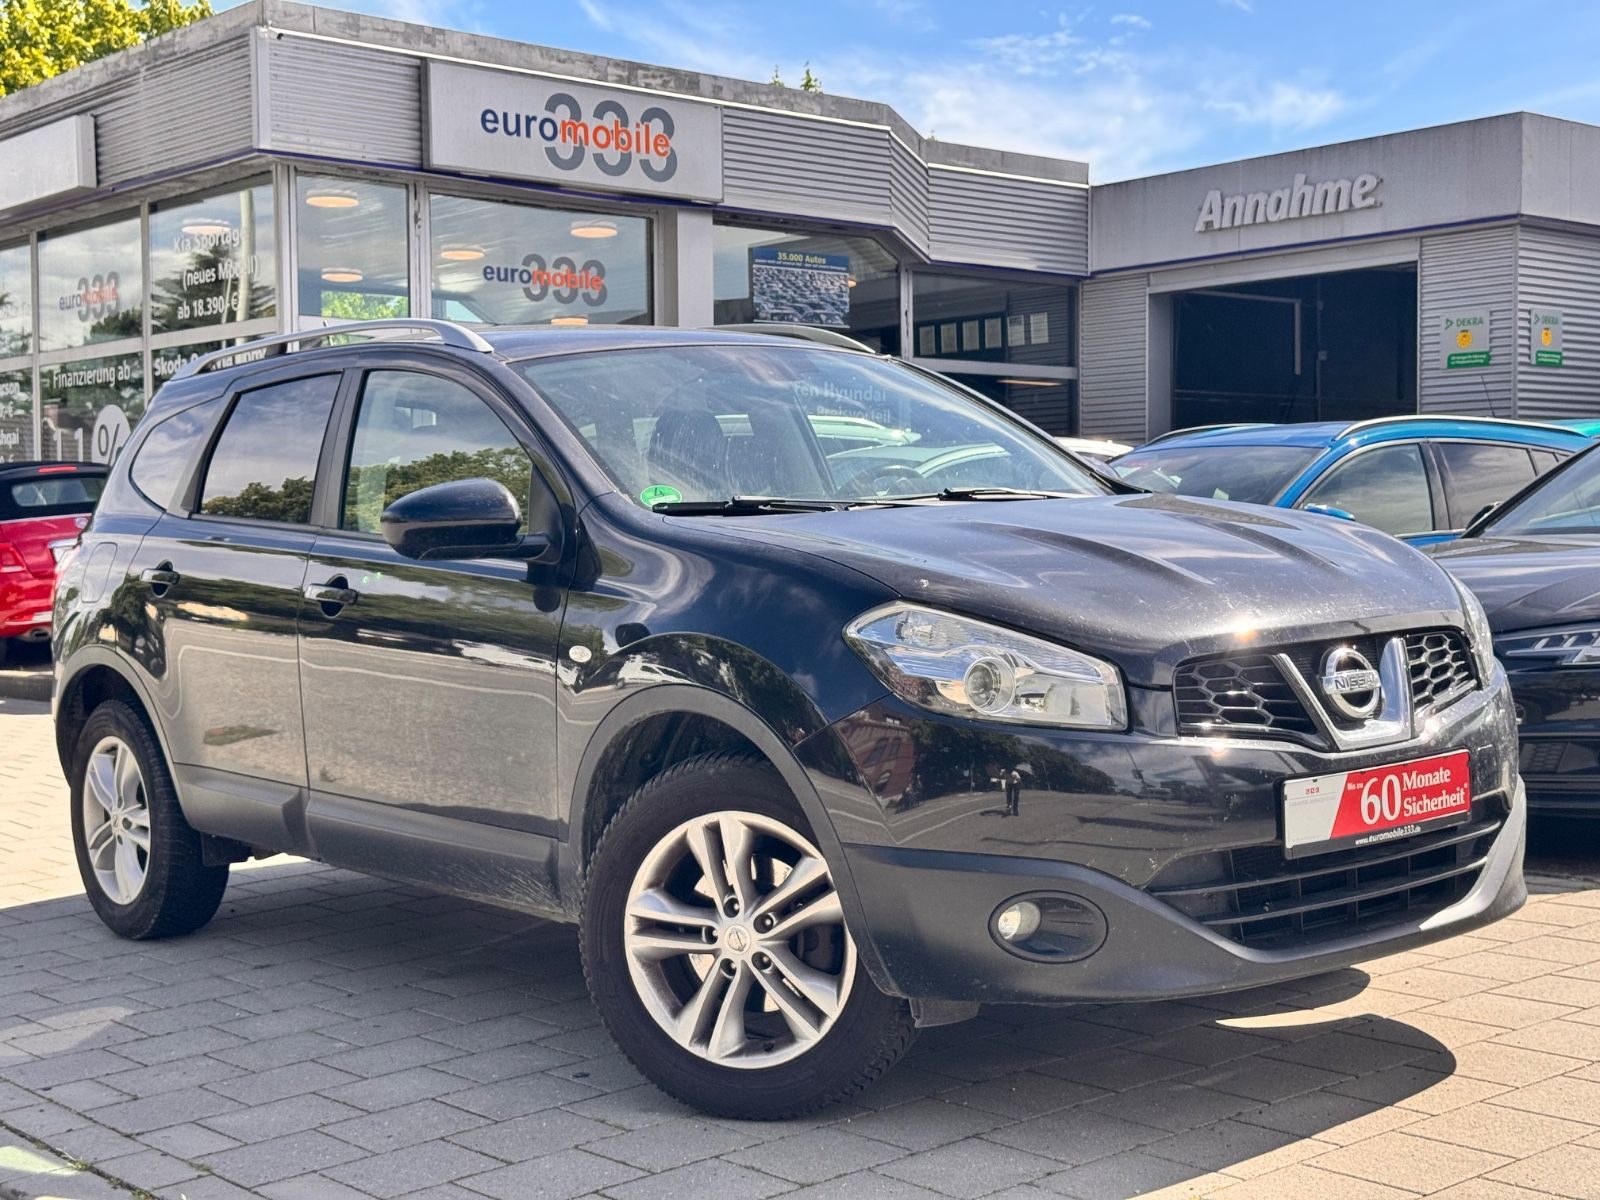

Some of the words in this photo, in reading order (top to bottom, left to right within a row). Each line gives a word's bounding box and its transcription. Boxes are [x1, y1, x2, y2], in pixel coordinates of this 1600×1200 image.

[480, 108, 671, 157] euromobile
[1194, 173, 1378, 232] Annahme
[174, 236, 192, 252] Kia
[777, 252, 803, 262] 35.000
[805, 255, 827, 265] Autos
[183, 267, 217, 291] (neues
[219, 256, 259, 282] Moll)
[483, 265, 605, 292] euromobile
[177, 301, 191, 320] ab
[1456, 317, 1484, 327] DEKRA
[53, 365, 116, 389] Finanzierung
[118, 361, 131, 381] ab
[154, 354, 188, 376] Skoda
[0, 381, 20, 399] cson
[1402, 767, 1451, 791] Monate
[1360, 774, 1401, 825] 60
[1355, 824, 1421, 846] www.euromobile333.de
